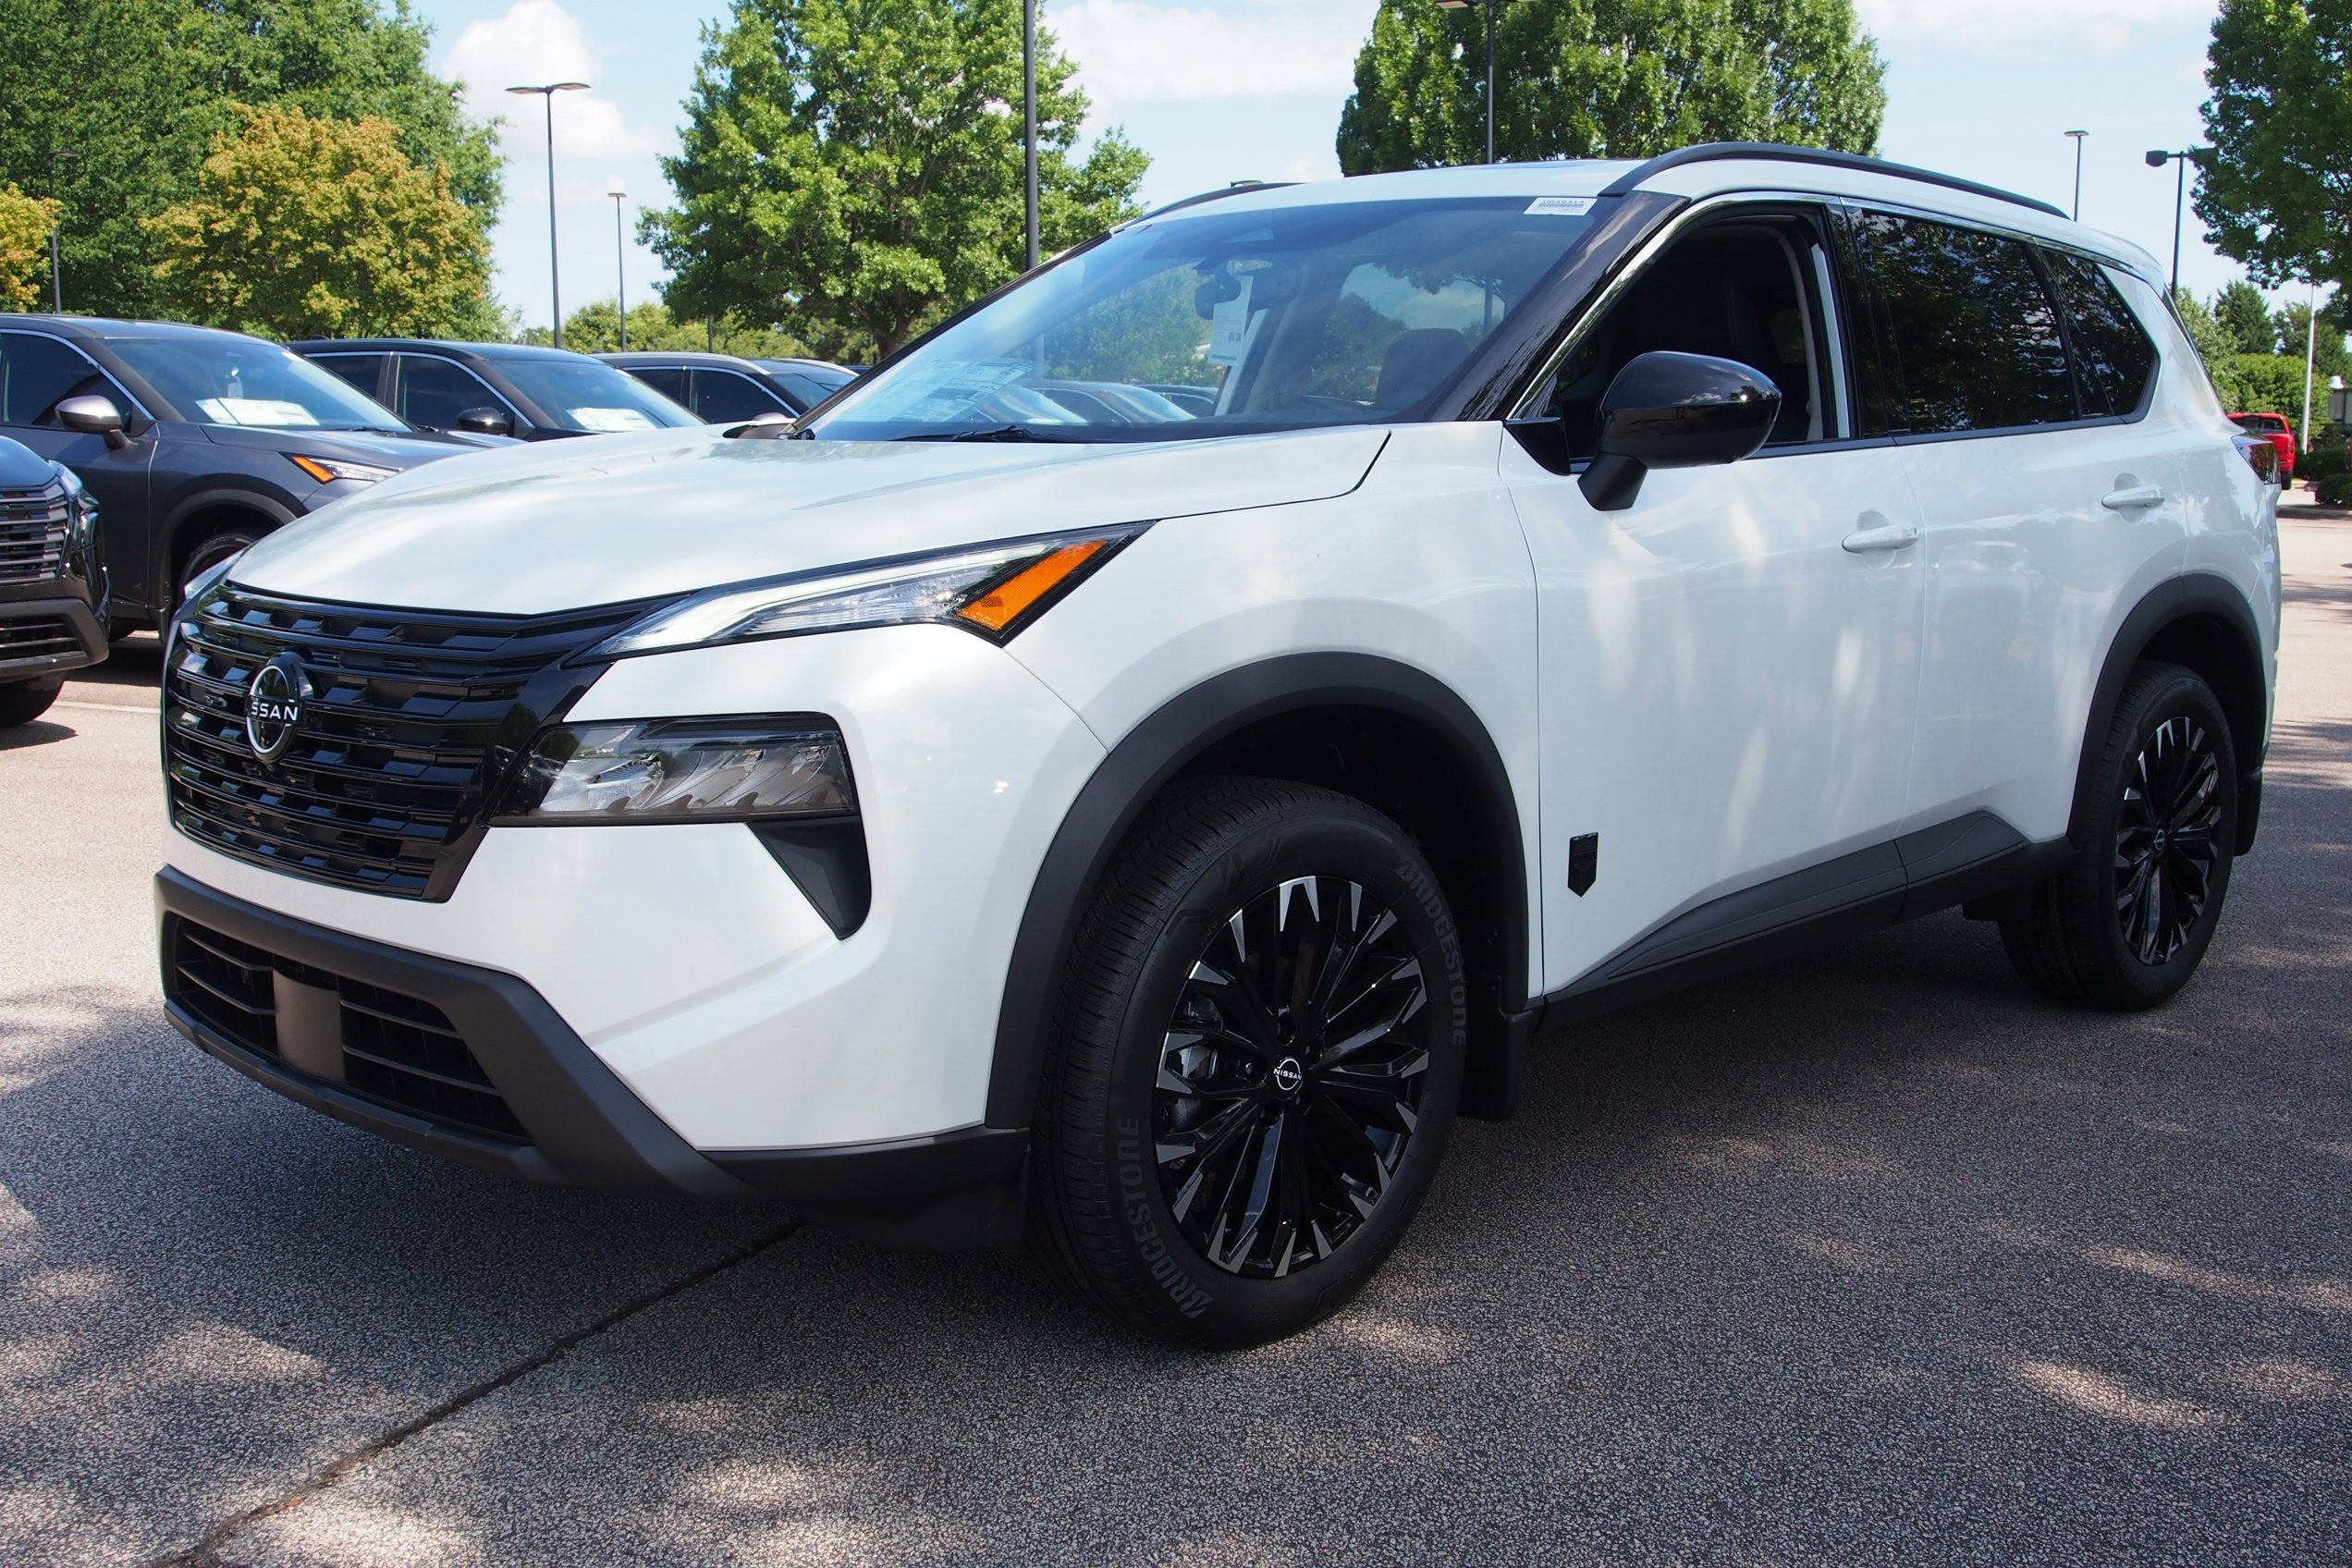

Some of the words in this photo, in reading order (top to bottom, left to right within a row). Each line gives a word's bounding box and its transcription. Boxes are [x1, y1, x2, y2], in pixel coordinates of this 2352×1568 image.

[250, 699, 298, 721] SSAN
[1394, 859, 1466, 1047] BRIDGESTONE
[1273, 1068, 1303, 1081] NISSAN
[1116, 1115, 1214, 1319] BRIDGESTONE
